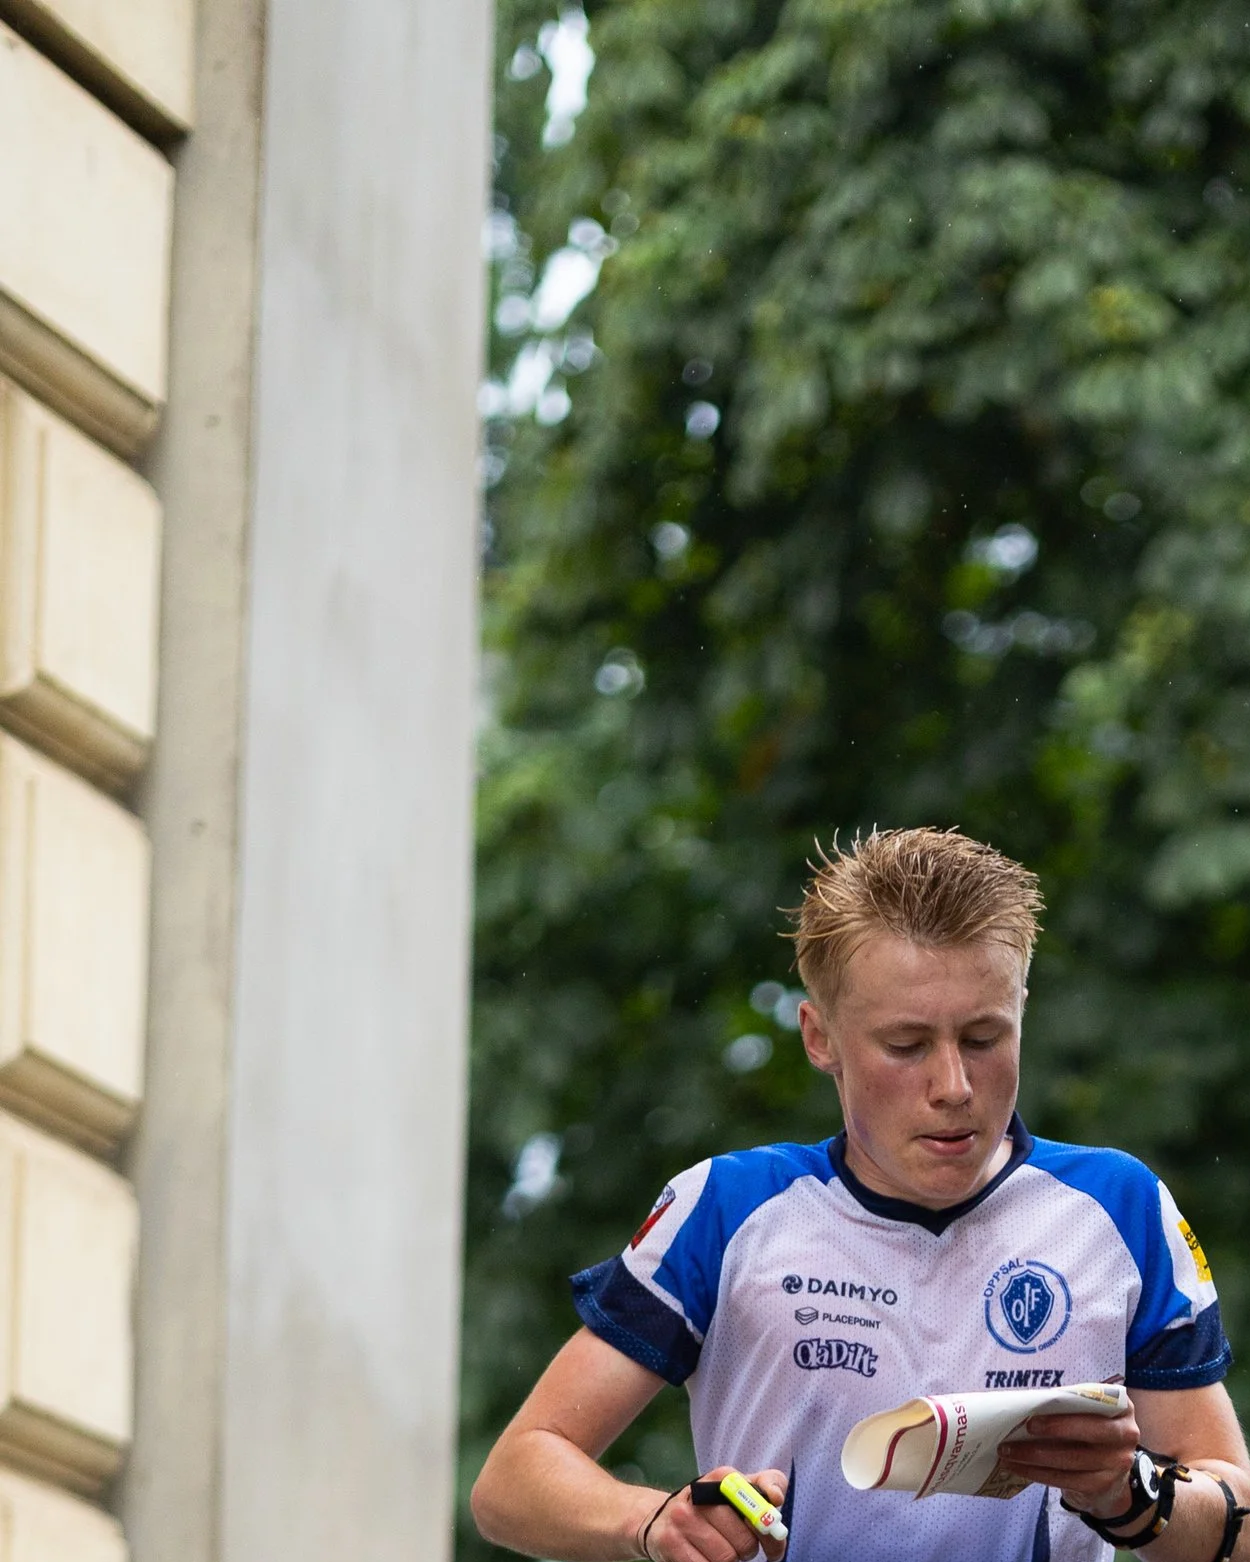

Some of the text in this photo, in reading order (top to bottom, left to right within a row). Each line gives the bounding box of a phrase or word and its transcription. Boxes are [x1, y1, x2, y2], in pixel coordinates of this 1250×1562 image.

[983, 1258, 1024, 1298] OPPSAL
[807, 1277, 898, 1306] DAIMYO
[822, 1312, 881, 1330] PLACEPOINT
[985, 1369, 1065, 1388] TRIMTEX
